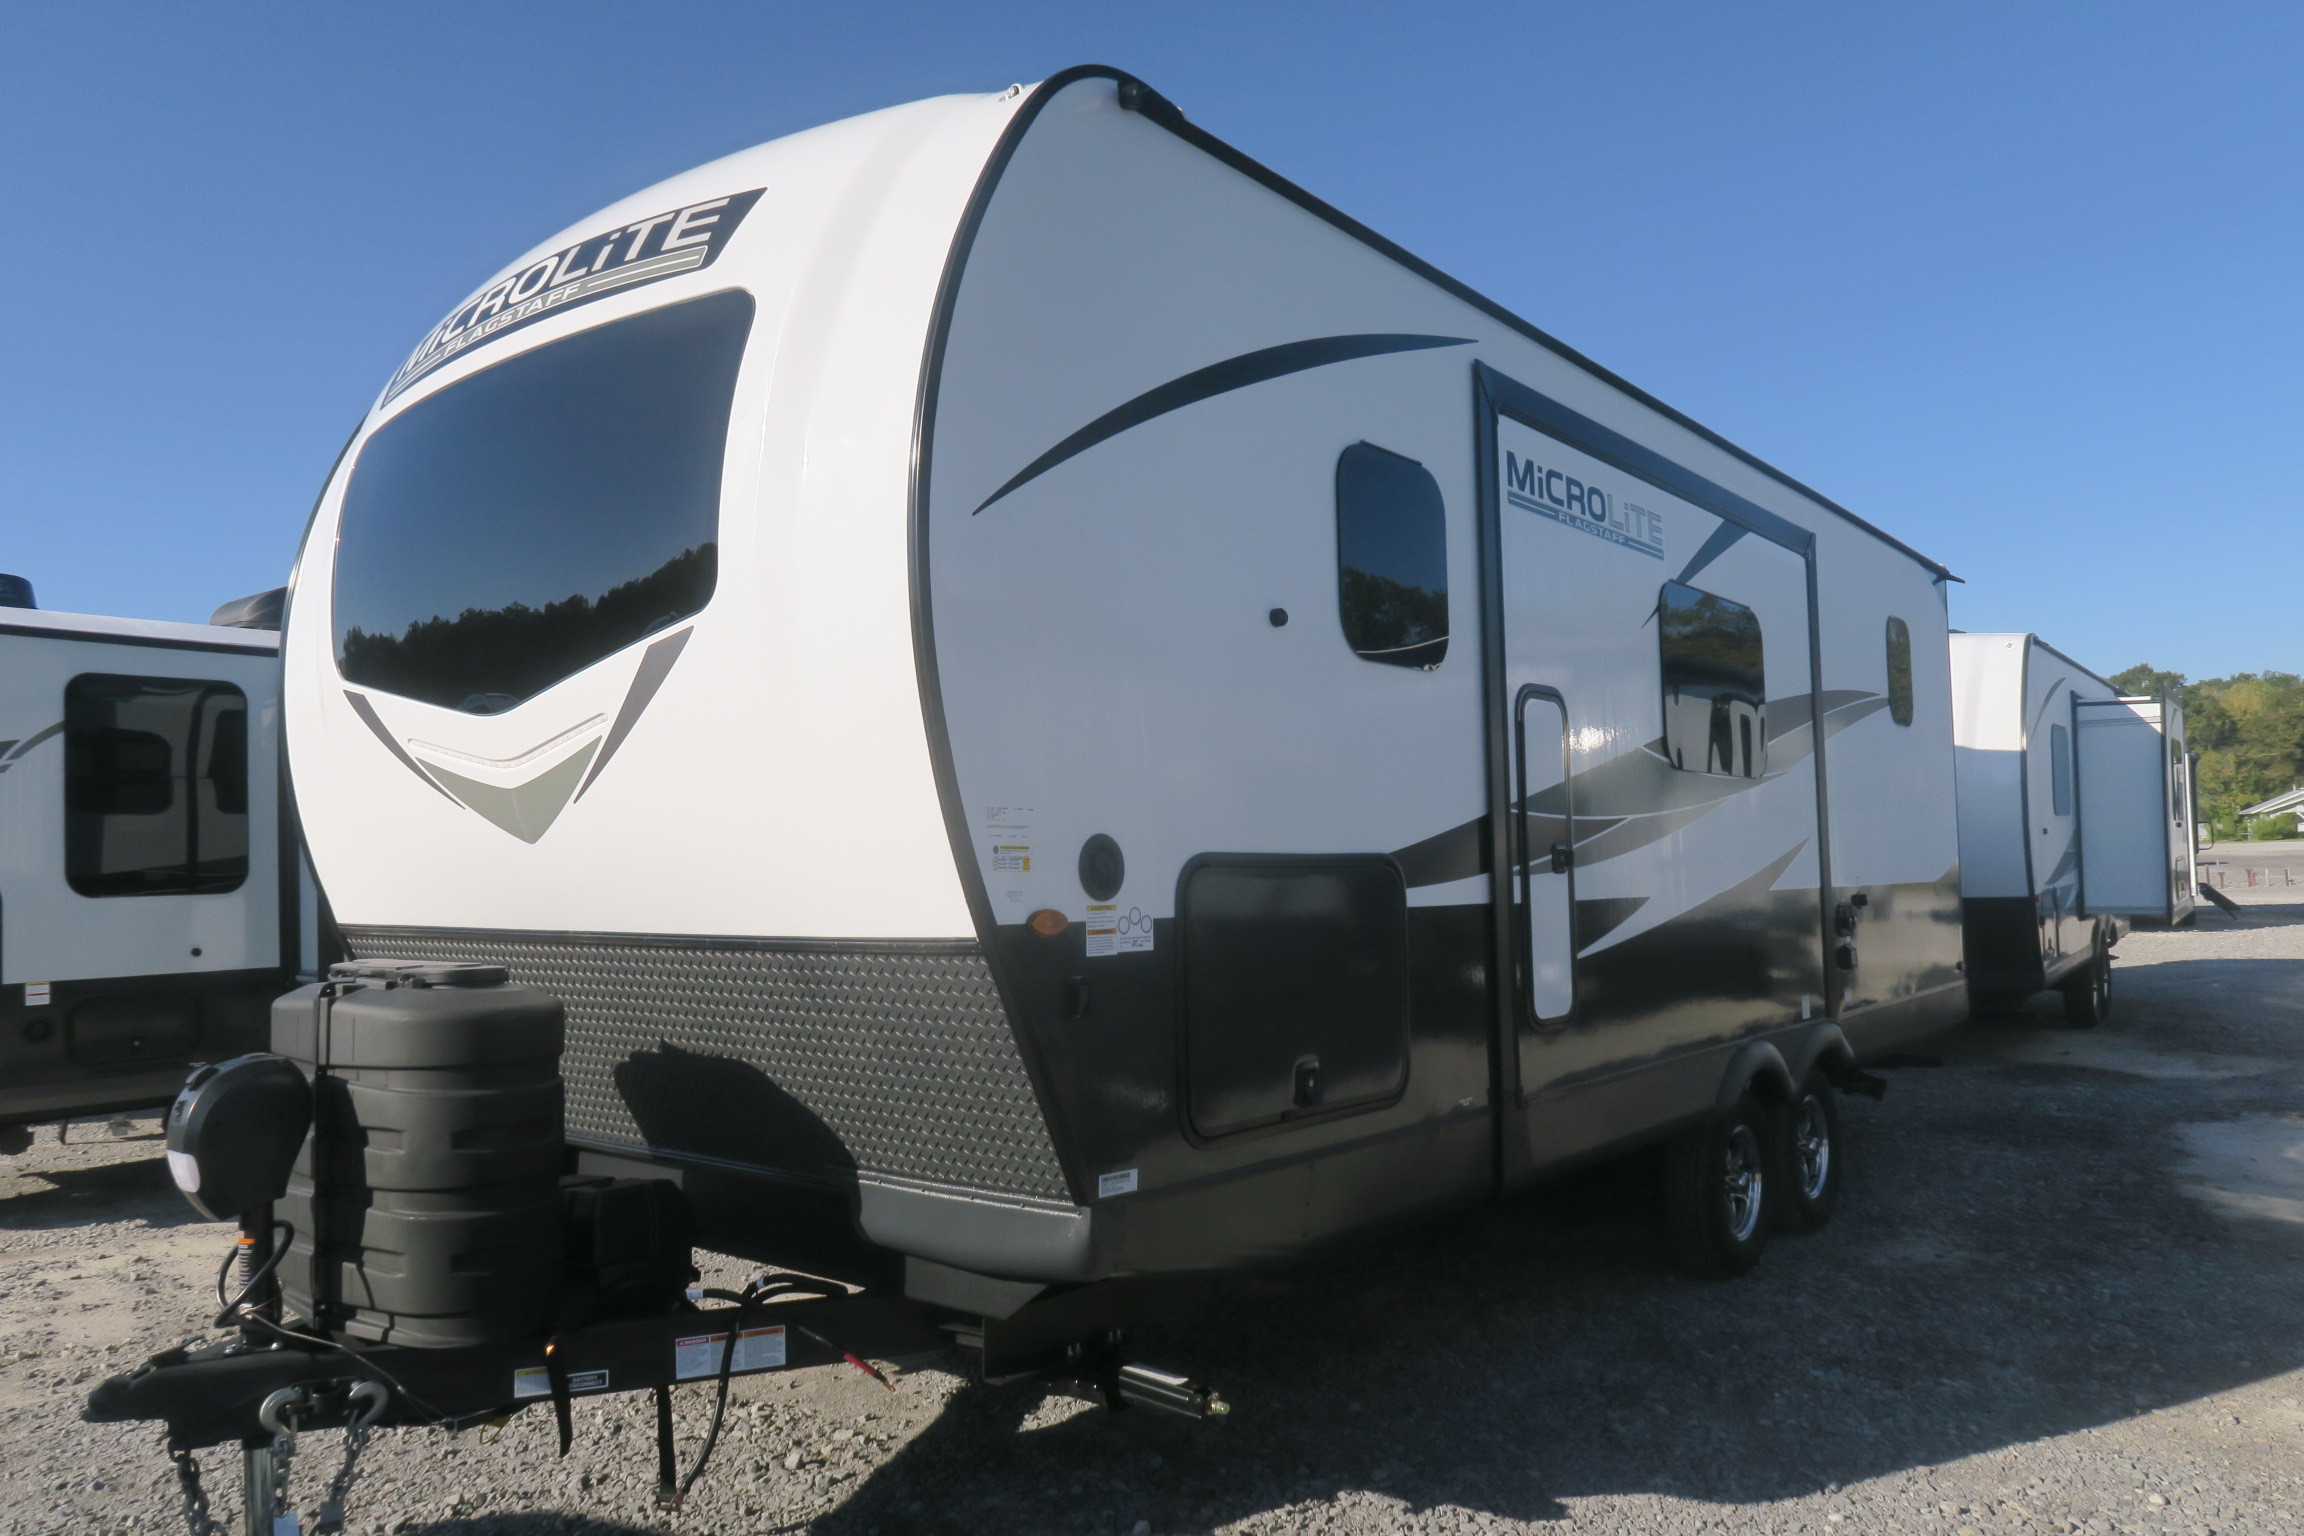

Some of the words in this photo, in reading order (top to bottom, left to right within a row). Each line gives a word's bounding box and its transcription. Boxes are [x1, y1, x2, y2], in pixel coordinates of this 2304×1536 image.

[444, 283, 581, 356] FLAGSTAFF
[1558, 512, 1627, 545] FLAGSTAFF
[684, 1338, 707, 1346] DANGER
[572, 1375, 598, 1383] BATTERY
